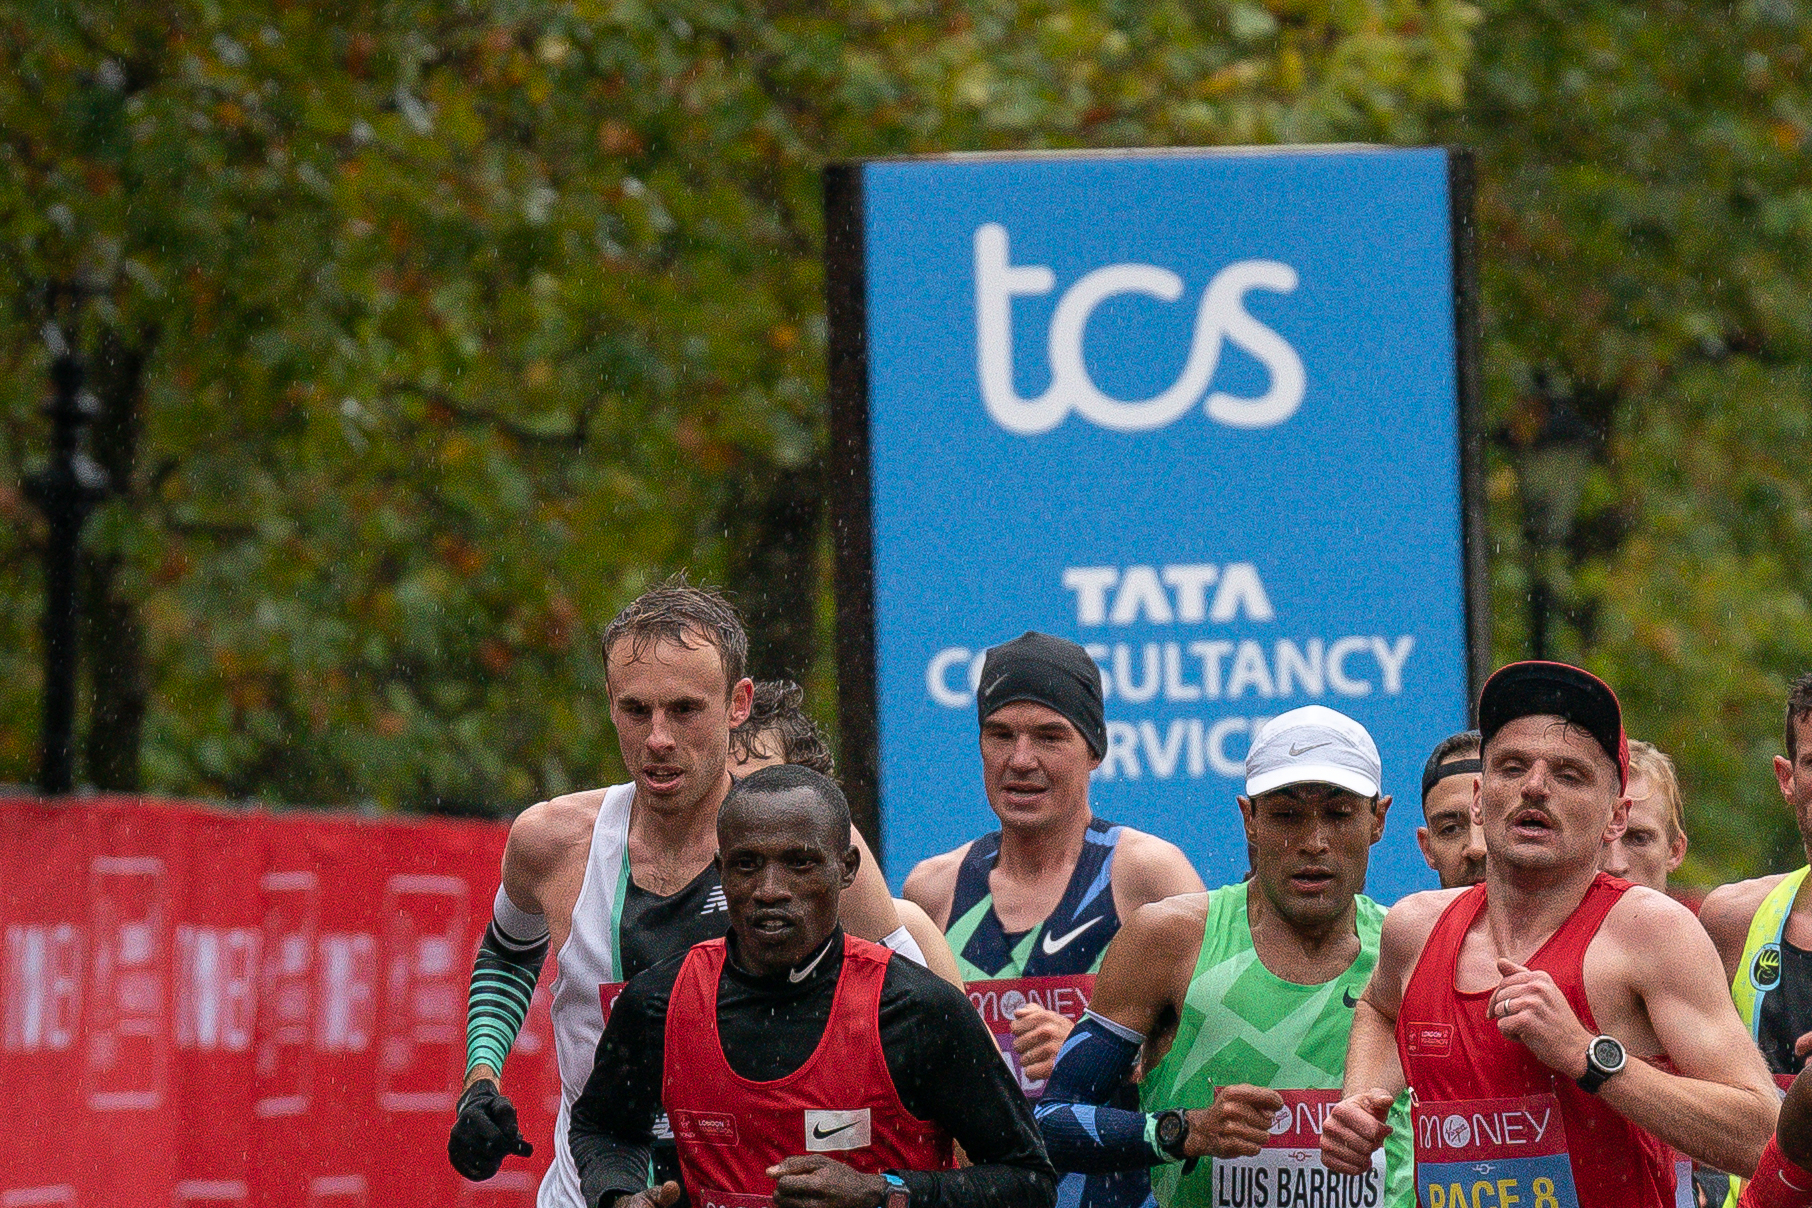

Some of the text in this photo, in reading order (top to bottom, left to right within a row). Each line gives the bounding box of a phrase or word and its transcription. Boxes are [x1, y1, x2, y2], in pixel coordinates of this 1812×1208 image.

[973, 222, 1306, 436] tcs
[1062, 561, 1274, 626] TATA
[926, 635, 1414, 707] CULTANCY
[1218, 1165, 1269, 1208] LUIS
